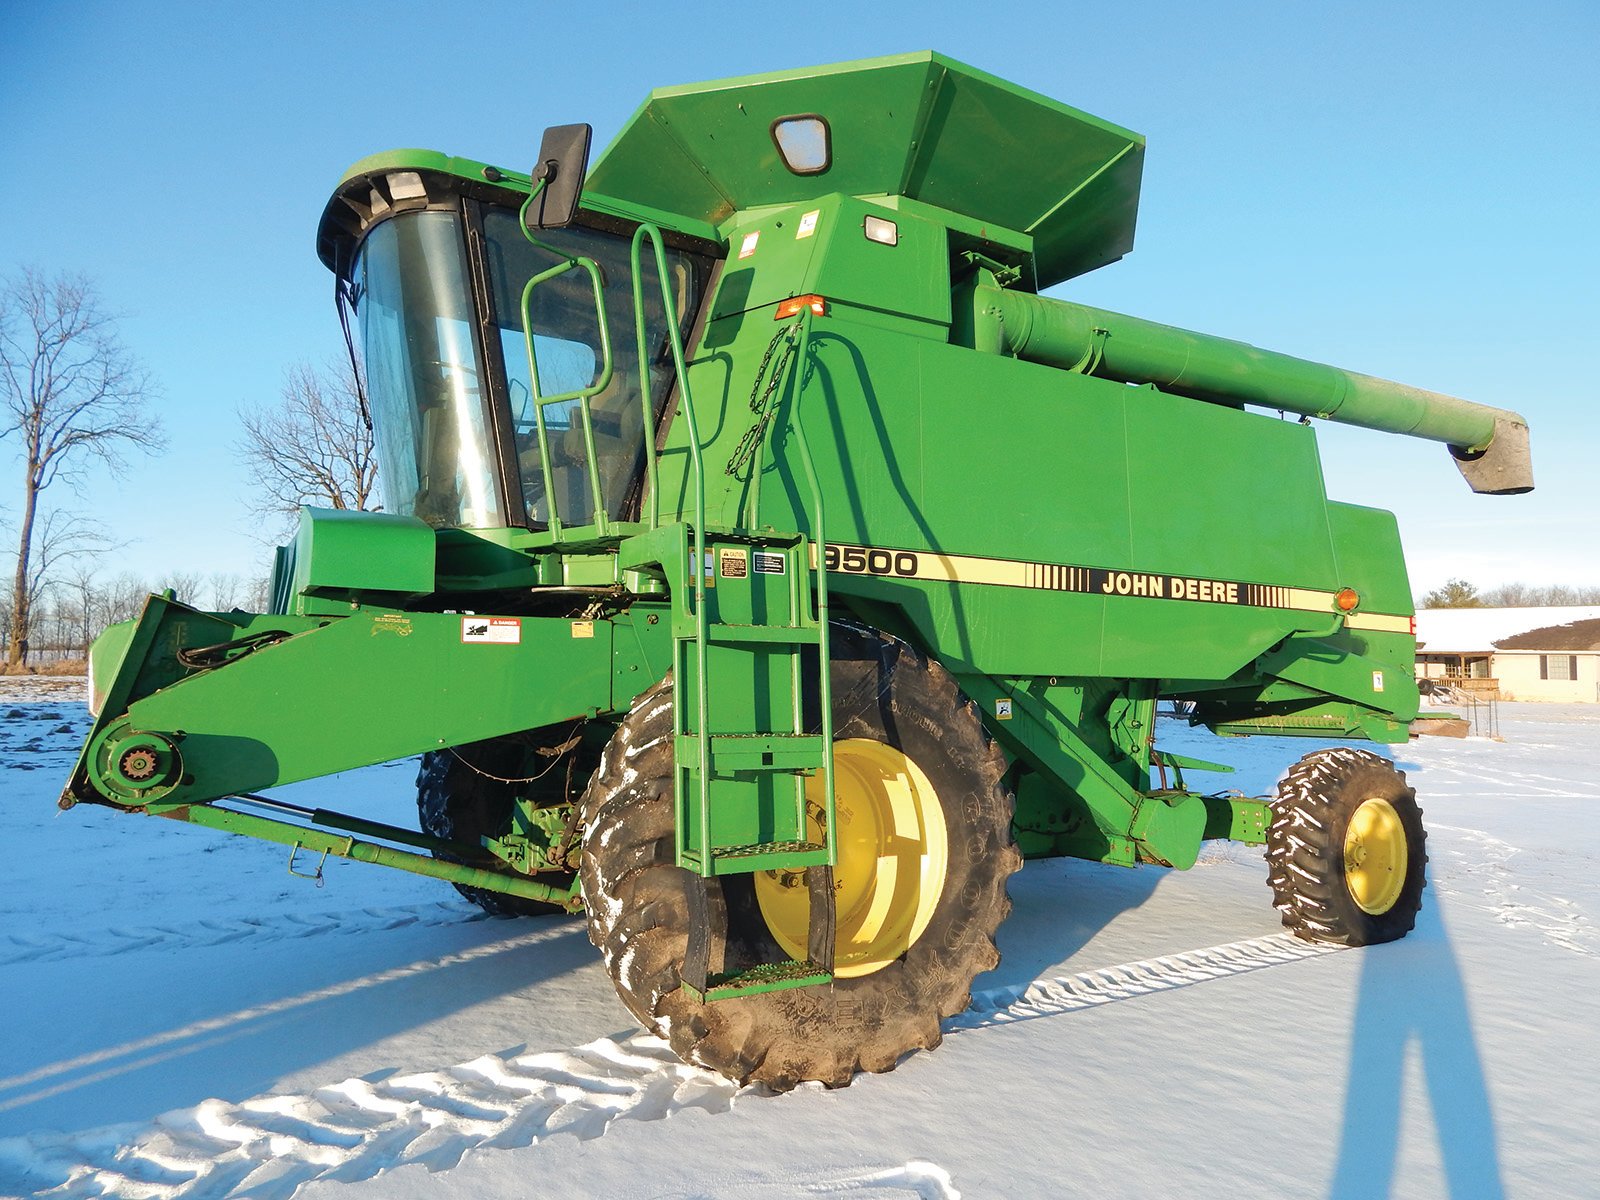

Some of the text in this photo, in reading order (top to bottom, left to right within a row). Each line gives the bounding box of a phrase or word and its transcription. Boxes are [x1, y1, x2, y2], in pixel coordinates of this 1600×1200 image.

[825, 545, 918, 576] 9500
[1102, 572, 1238, 603] JOHN DEERE
